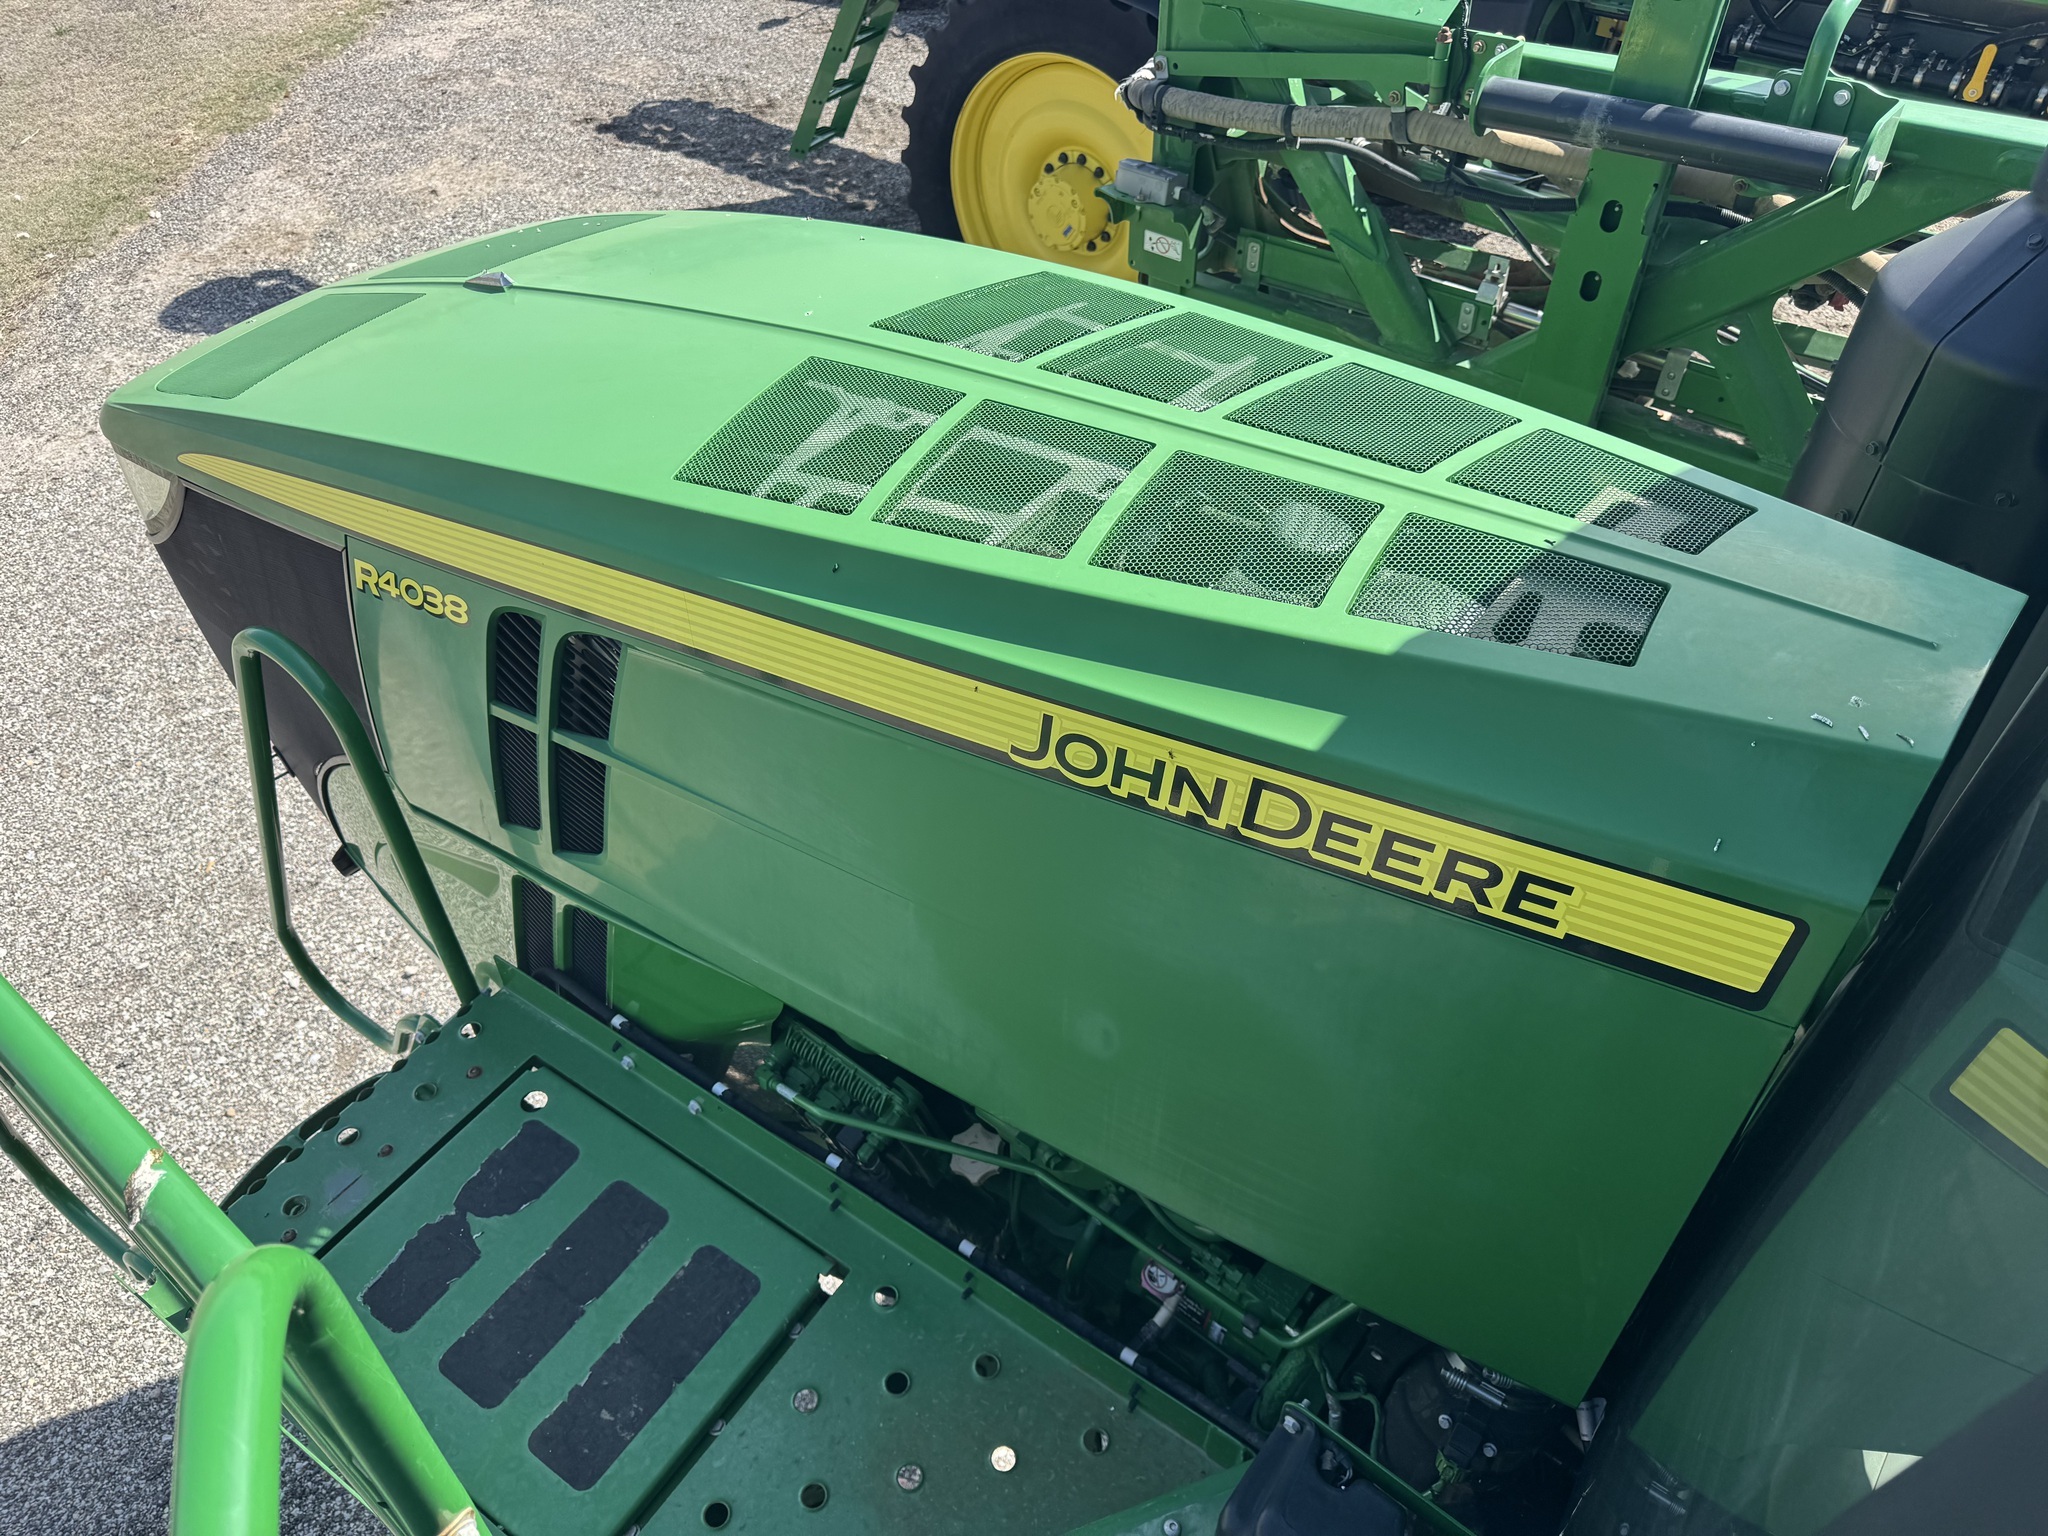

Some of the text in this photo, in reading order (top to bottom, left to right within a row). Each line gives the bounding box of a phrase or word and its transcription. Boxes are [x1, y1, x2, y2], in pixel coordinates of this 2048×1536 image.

[353, 558, 470, 626] R4038
[1009, 713, 1576, 931] JOHN DEERE
